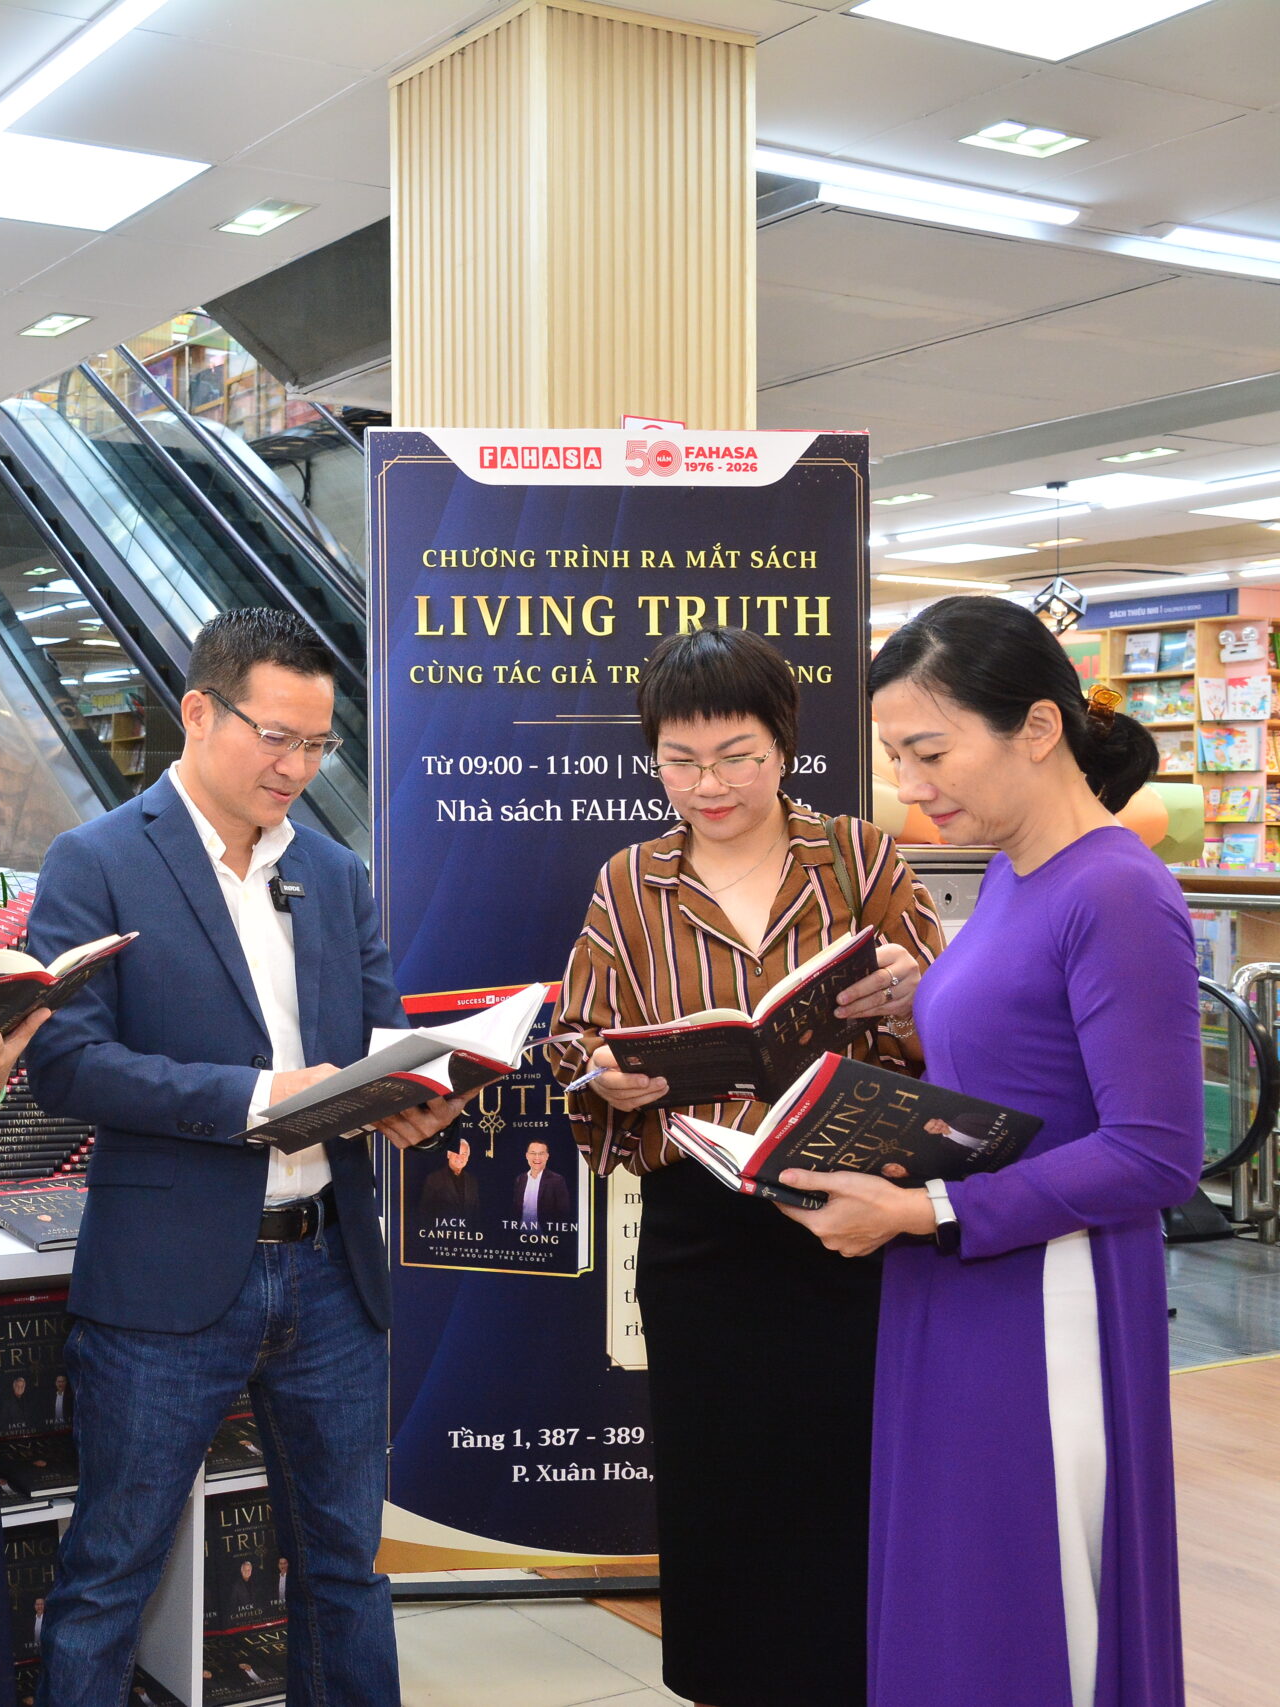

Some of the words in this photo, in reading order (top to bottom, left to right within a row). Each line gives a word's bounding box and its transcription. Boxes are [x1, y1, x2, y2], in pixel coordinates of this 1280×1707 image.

[479, 446, 602, 469] FAHASA
[625, 440, 682, 477] 50
[685, 446, 758, 459] FAHASA
[685, 462, 714, 472] 1976
[726, 462, 758, 472] 2026
[422, 546, 536, 568] CHƯƠNG
[546, 544, 629, 568] TRÌNH
[640, 550, 675, 568] RA
[685, 543, 740, 568] MẮT
[750, 545, 818, 568] SÁCH
[414, 595, 616, 636] LIVING
[638, 595, 831, 636] TRUTH
[409, 660, 483, 684] CÙNG
[493, 660, 541, 684] TÁC
[551, 659, 598, 684] GIẢ
[421, 755, 453, 775] Từ
[459, 755, 522, 775] 09:00
[546, 755, 608, 775] 11:00
[436, 798, 492, 822] Nhà
[500, 798, 563, 822] sách
[570, 798, 682, 822] FAHASA
[457, 997, 486, 1006] SUCCESS
[524, 1072, 542, 1080] FIND
[461, 1085, 570, 1116] UTH
[0, 1127, 26, 1135] LIVING
[8, 1118, 35, 1126] LIVING
[801, 1079, 881, 1171] IVING
[830, 1089, 920, 1172] RUTH
[435, 1217, 466, 1228] JACK
[502, 1220, 539, 1230] TRAN
[547, 1222, 579, 1232] TIEN
[419, 1229, 484, 1241] CANFIELD
[520, 1234, 560, 1245] CONG
[461, 1252, 494, 1260] AROUND
[484, 1249, 553, 1258] PROFESSIONALS
[448, 1426, 505, 1451] Tầng
[512, 1428, 531, 1450] 1,
[538, 1427, 579, 1446] 387
[602, 1426, 645, 1445] 389
[511, 1464, 529, 1483] P.
[536, 1462, 596, 1482] Xuân
[603, 1461, 655, 1483] Hòa,
